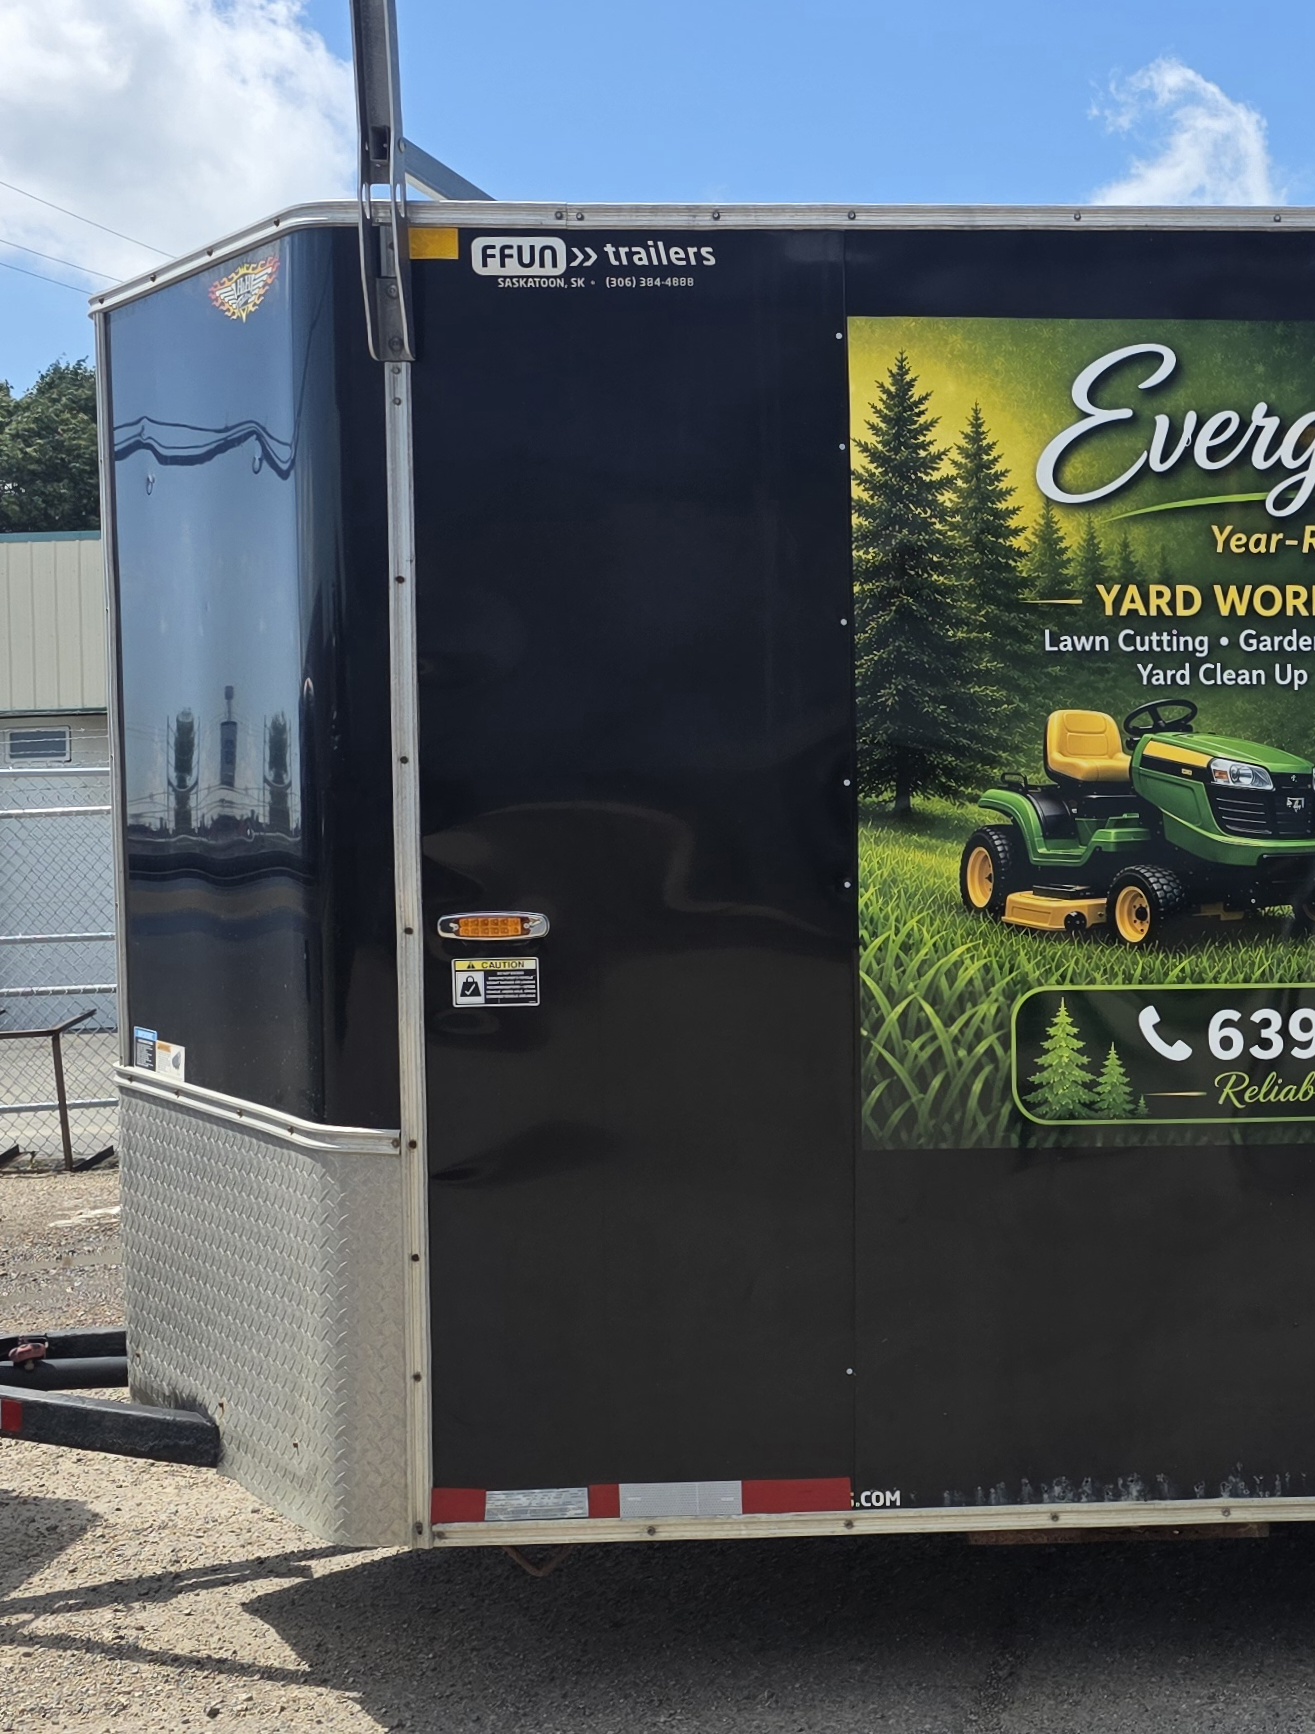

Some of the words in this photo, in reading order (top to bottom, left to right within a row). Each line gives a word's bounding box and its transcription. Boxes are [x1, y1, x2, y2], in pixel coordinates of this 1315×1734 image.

[604, 240, 716, 266] trailers
[498, 277, 567, 289] SASKATOON,
[571, 277, 585, 288] SK
[606, 276, 636, 289] (306)
[640, 276, 694, 287] 384-4888
[1097, 584, 1202, 617] YARD
[1044, 629, 1110, 652] Lawn
[1118, 629, 1209, 657] Cutting
[1137, 664, 1190, 686] Yard
[1198, 664, 1265, 686] Clean
[1274, 664, 1308, 691] Up
[481, 961, 525, 969] CAUTION
